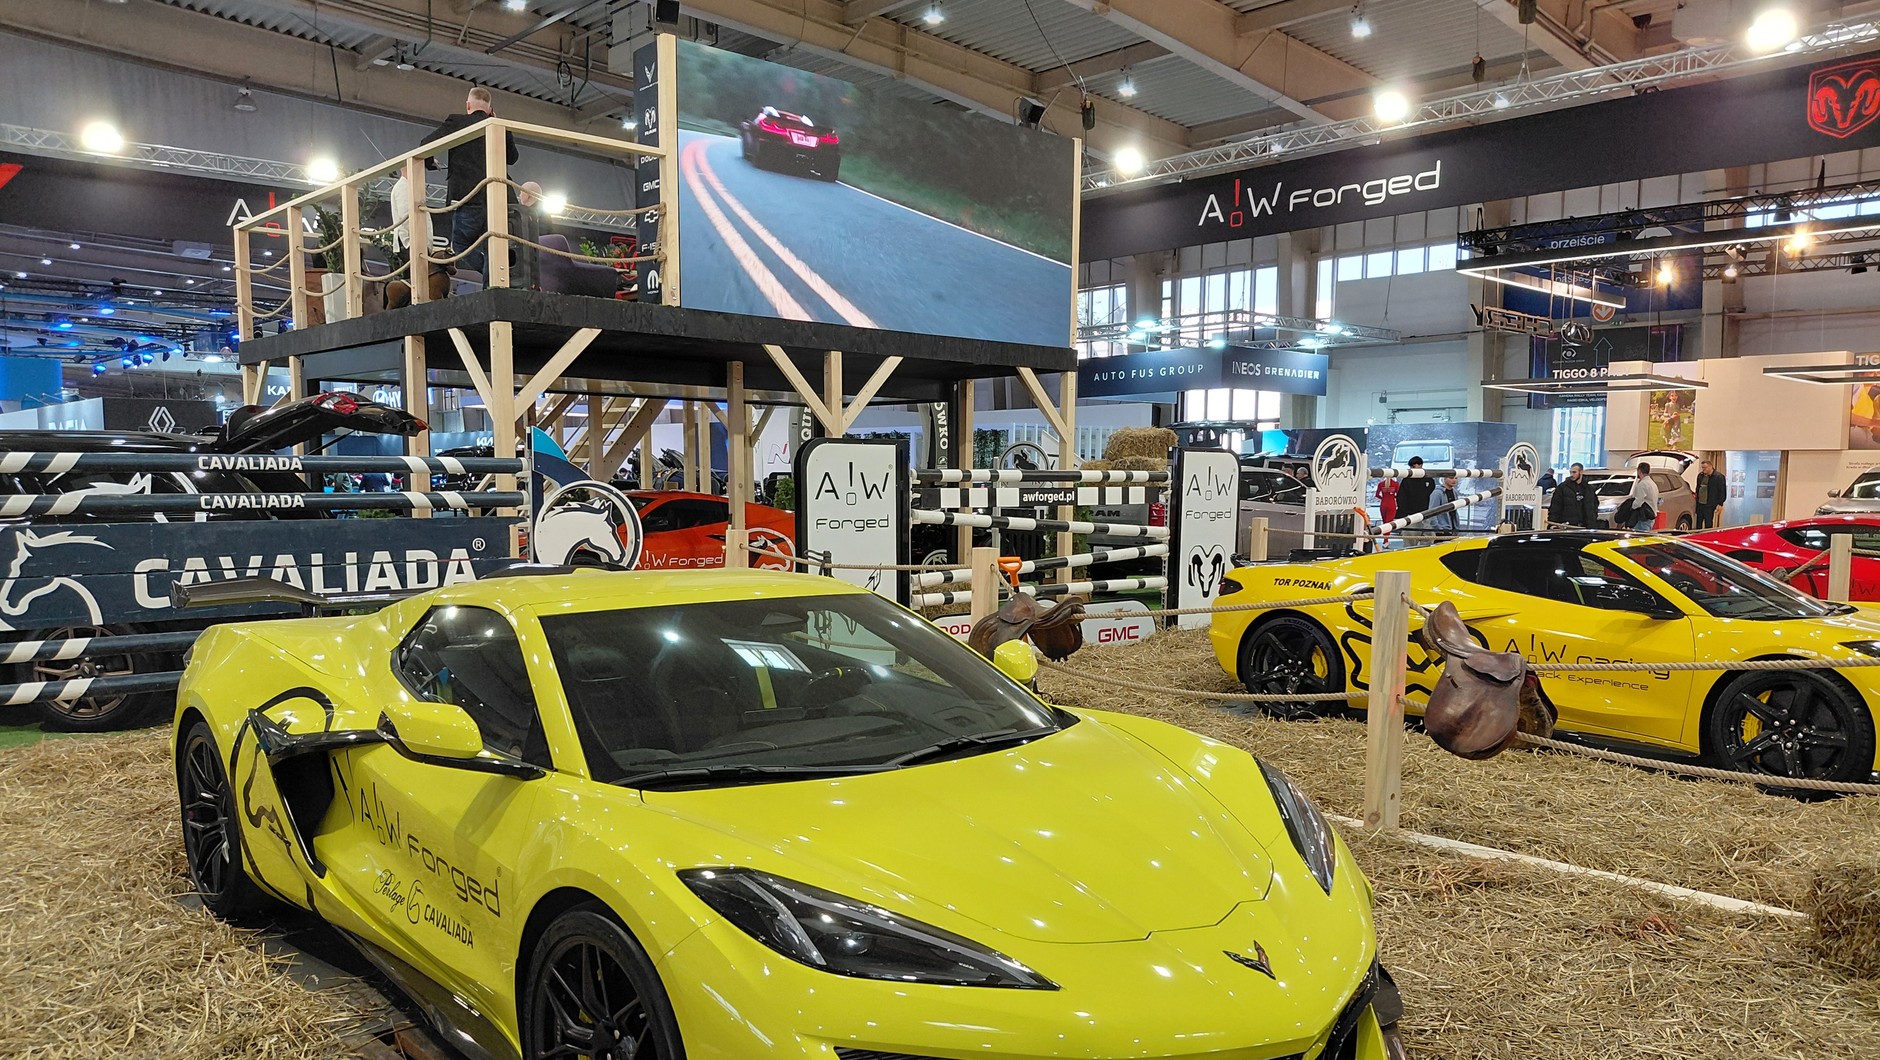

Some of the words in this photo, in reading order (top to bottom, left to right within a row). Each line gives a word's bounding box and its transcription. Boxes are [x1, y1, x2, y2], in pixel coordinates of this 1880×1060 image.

[642, 179, 660, 192] GMC
[1093, 370, 1126, 382] AUTO
[1131, 368, 1154, 379] FUS
[1159, 364, 1204, 376] GROUP
[1232, 361, 1261, 376] INEOS
[1264, 366, 1320, 380] GRENADIER
[1552, 368, 1588, 379] TIGGO
[1590, 368, 1598, 377] 8
[198, 456, 304, 471] CAVALIADA
[200, 494, 305, 509] CAVALIADA
[1022, 490, 1075, 503] awforged.pl
[1315, 494, 1358, 506] BABORÓWKO
[1273, 578, 1292, 587] TOR
[1292, 579, 1333, 591] POZNAŃ
[1098, 625, 1140, 643] GMC
[1576, 655, 1671, 681] racig
[1536, 670, 1562, 680] ack
[1567, 674, 1650, 692] Experience
[373, 868, 406, 914] Perlage
[424, 904, 474, 950] CAVALIADA
